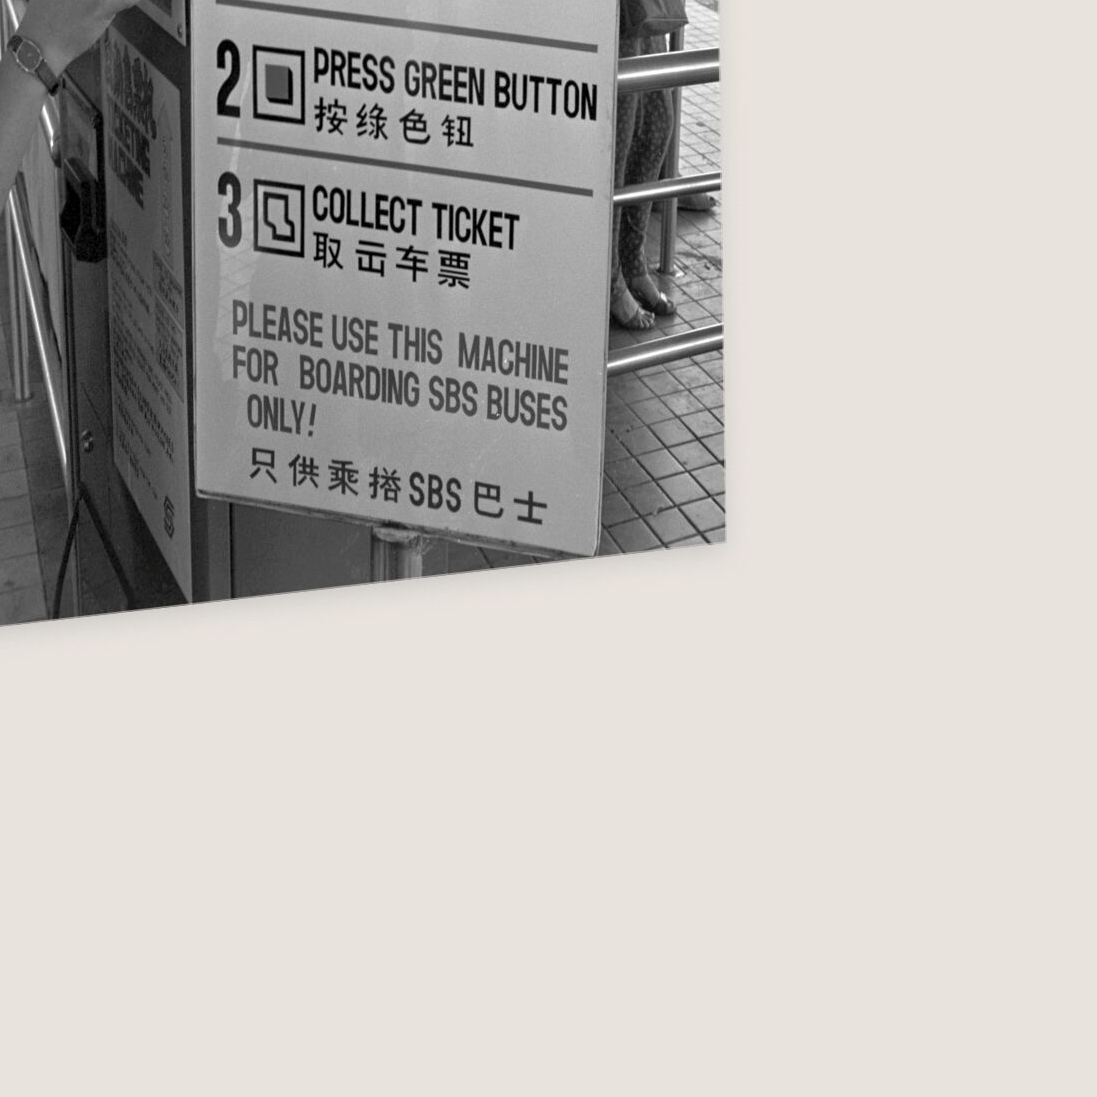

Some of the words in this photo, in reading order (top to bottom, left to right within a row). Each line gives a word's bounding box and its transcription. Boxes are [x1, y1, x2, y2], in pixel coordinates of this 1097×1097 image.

[216, 39, 242, 118] 2
[314, 46, 396, 95] PRESS
[404, 59, 486, 107] GREEN
[494, 70, 598, 122] BUTTON
[314, 96, 475, 148] 按绿色钮
[218, 170, 243, 249] 3
[312, 184, 424, 237] COLLECT
[432, 201, 520, 251] TICKET
[232, 300, 324, 349] PLEASE
[332, 313, 379, 357] USE
[388, 321, 443, 366] THIS
[458, 332, 569, 386] MACHINE
[232, 345, 279, 386] FOR
[300, 354, 421, 408] BOARDING
[429, 374, 479, 418] SBS
[487, 384, 568, 432] BUSES
[246, 393, 317, 438] ONLY!
